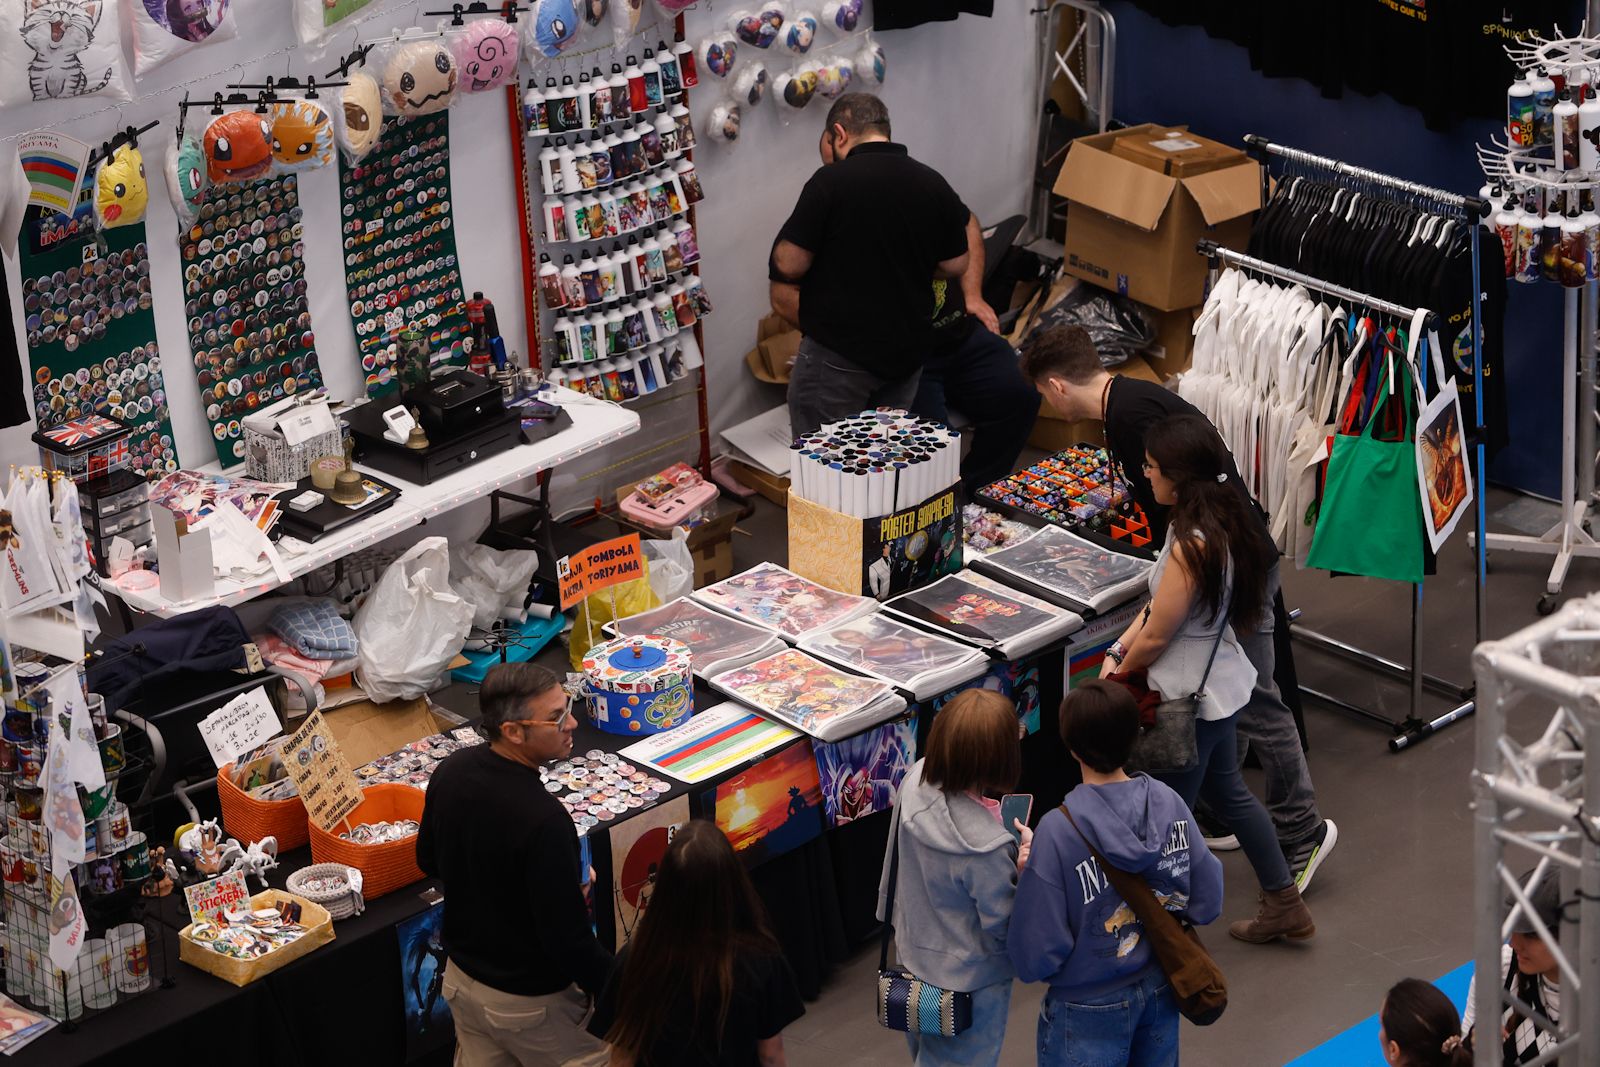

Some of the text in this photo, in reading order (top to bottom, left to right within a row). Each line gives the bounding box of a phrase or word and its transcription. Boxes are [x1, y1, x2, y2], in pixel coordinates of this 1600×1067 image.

[880, 492, 954, 543] PÓSTER SORPRESA
[8, 547, 30, 596] GREMLINS
[587, 544, 634, 567] TOMBOLA
[563, 560, 640, 600] AKIRA TORIYAMA
[283, 734, 302, 755] CHAPAS
[198, 888, 247, 912] STICKERS
